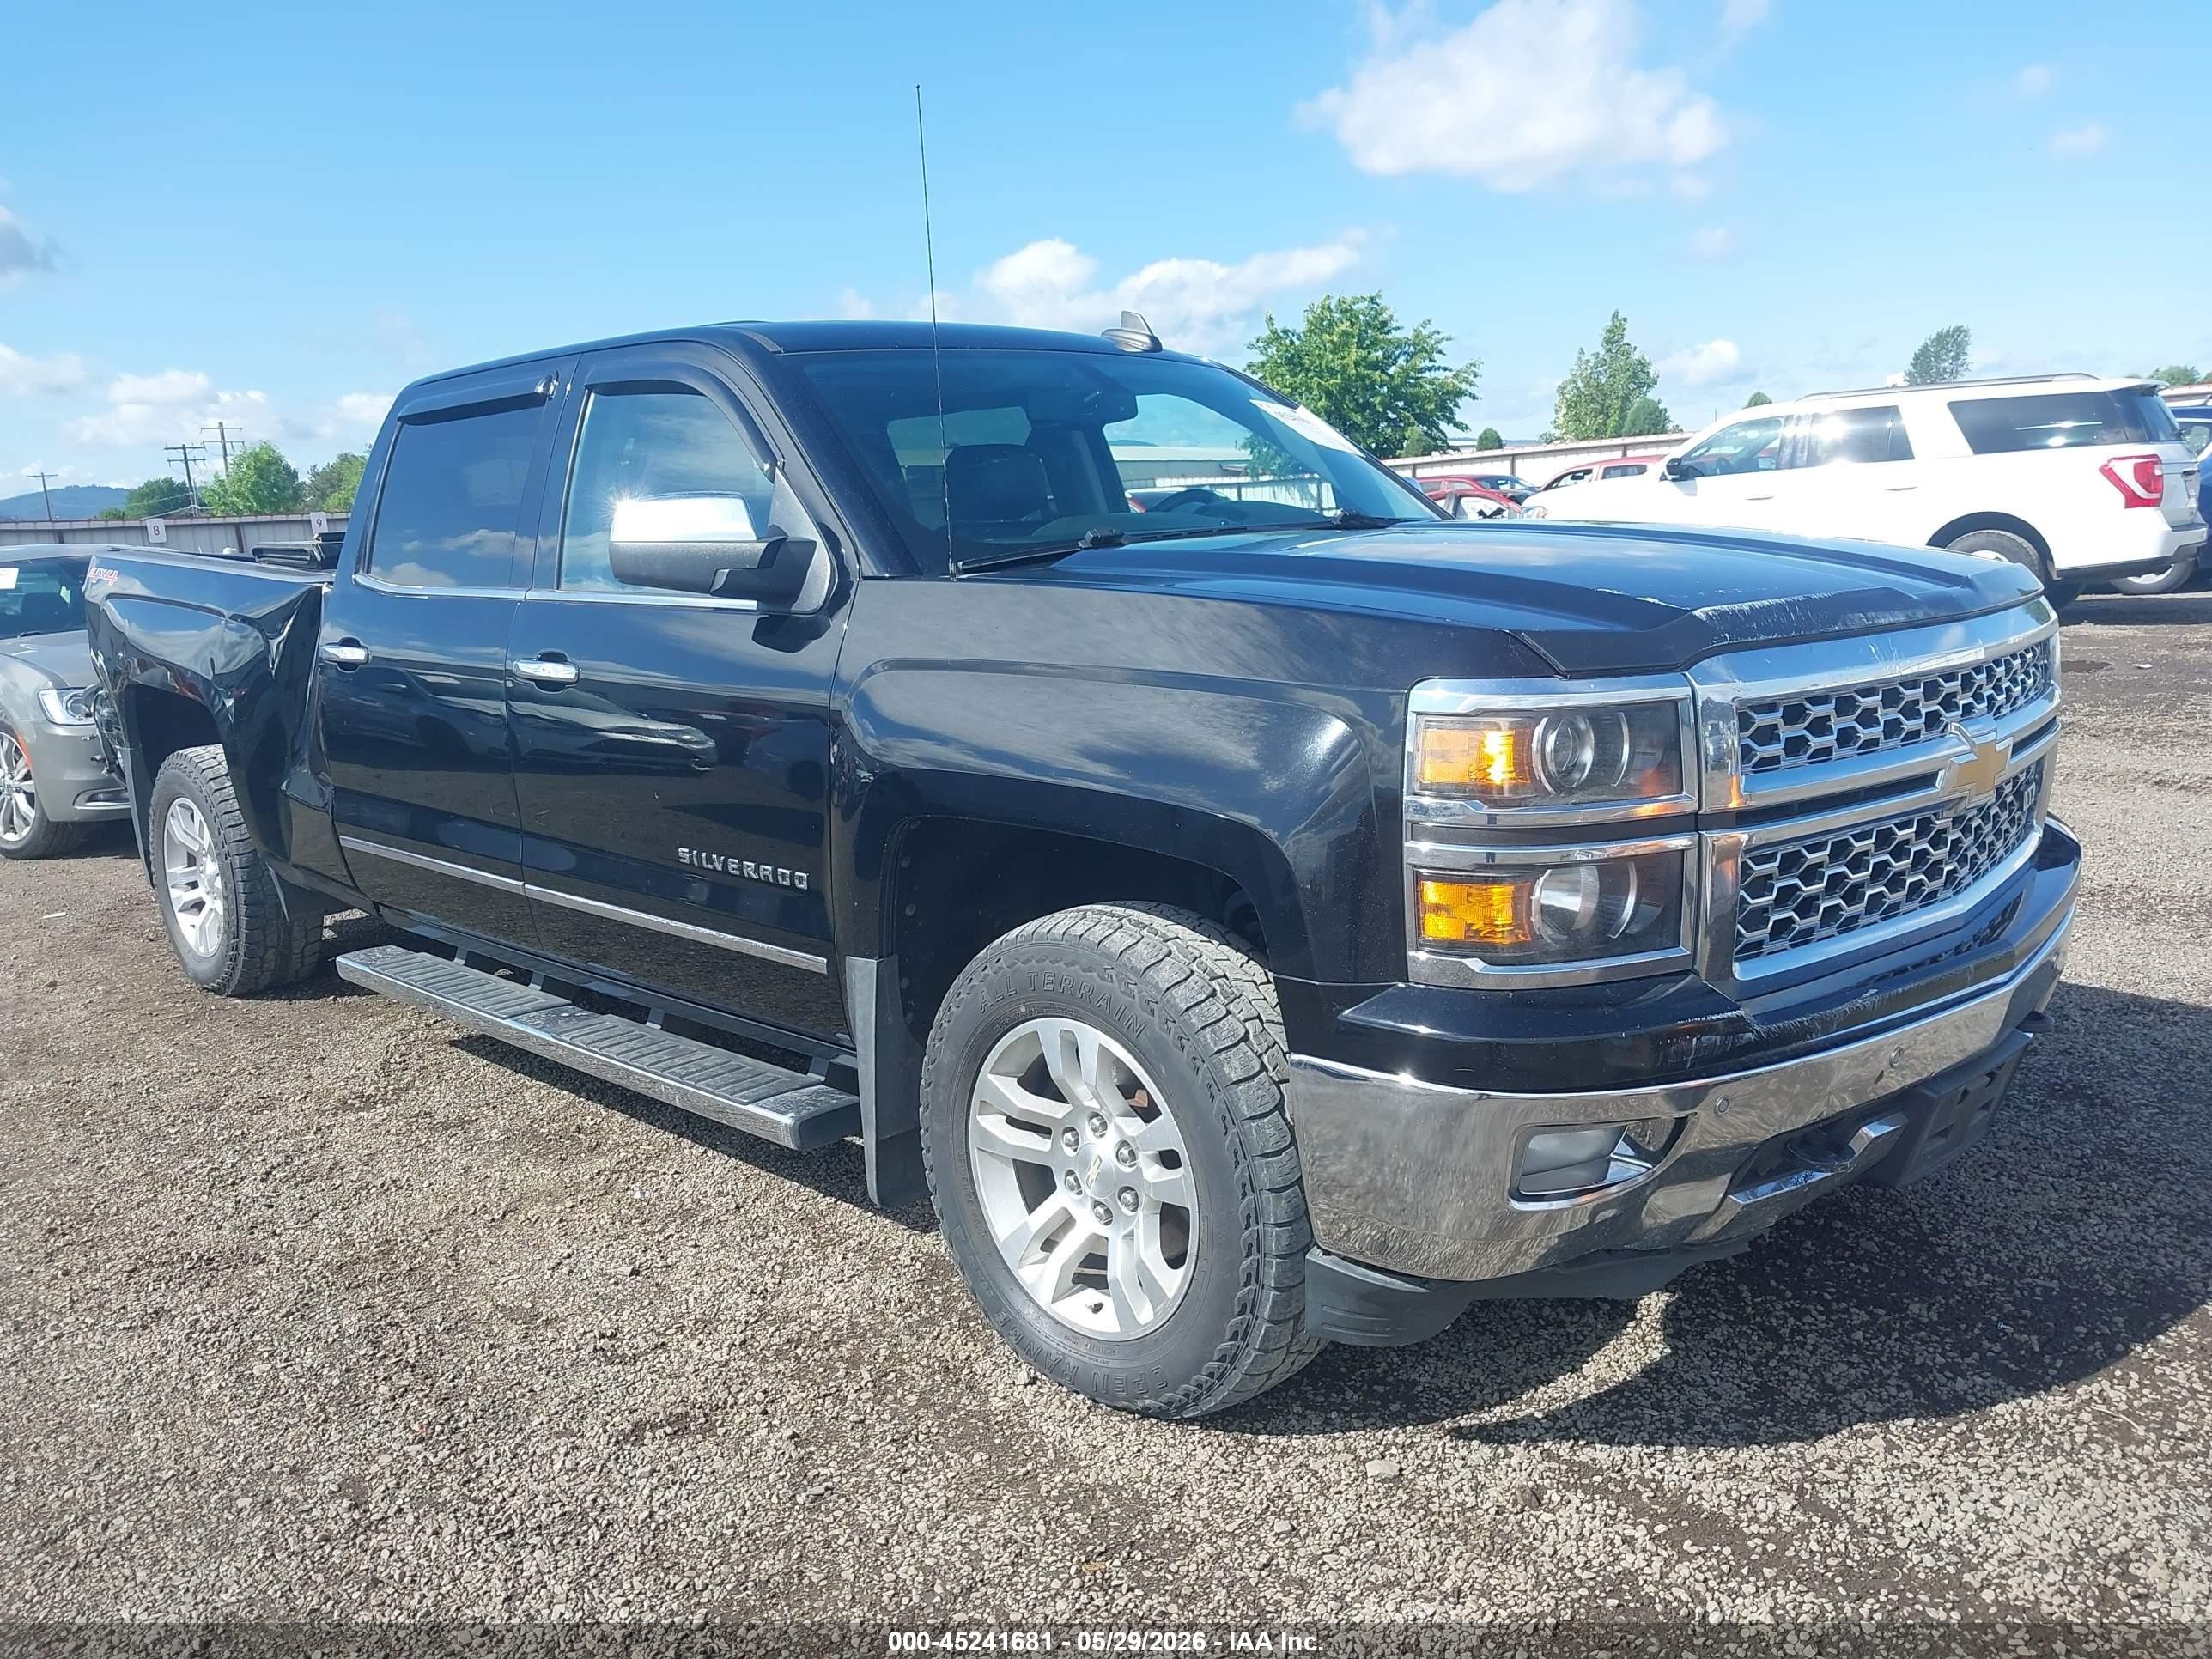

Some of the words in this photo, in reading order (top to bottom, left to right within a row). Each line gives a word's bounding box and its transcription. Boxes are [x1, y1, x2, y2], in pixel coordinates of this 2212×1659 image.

[153, 525, 161, 536] 8
[316, 518, 322, 528] 9
[678, 847, 810, 890] SILVERADO
[979, 975, 1018, 1013] ALL
[1027, 970, 1147, 1038] TERRAIN
[996, 1310, 1079, 1386] RANGE
